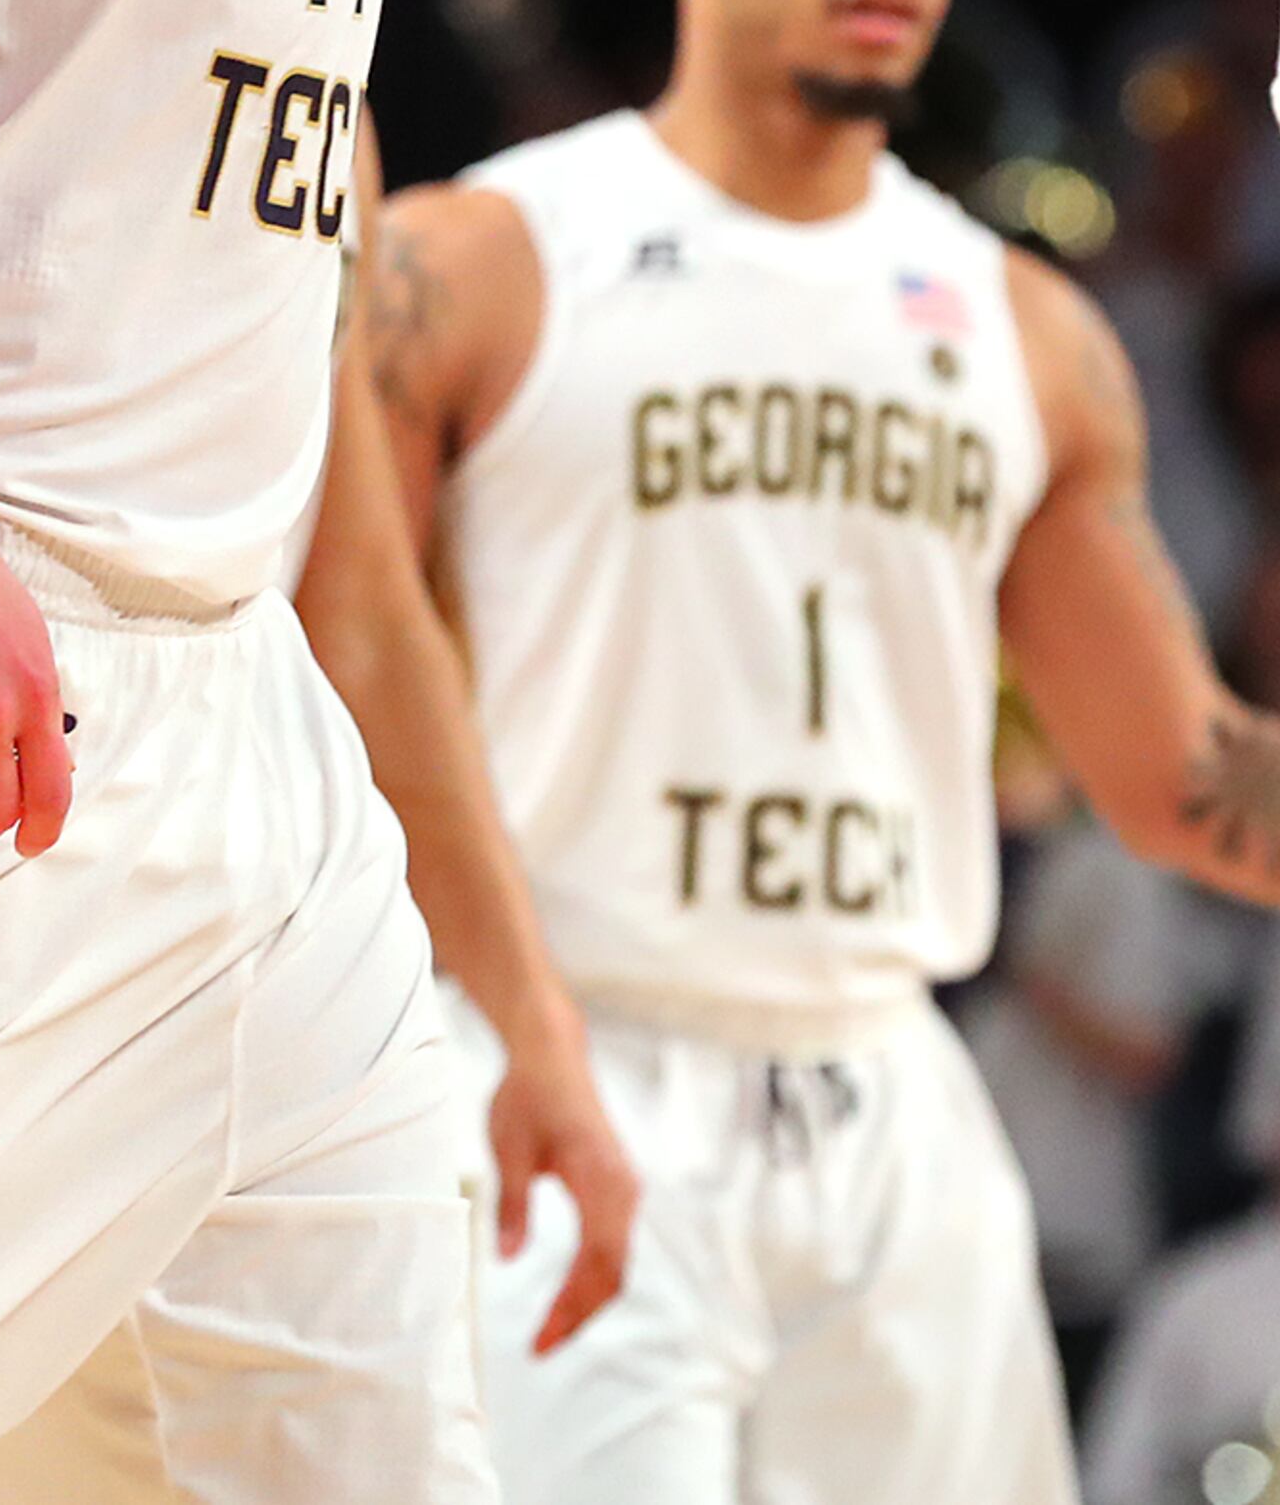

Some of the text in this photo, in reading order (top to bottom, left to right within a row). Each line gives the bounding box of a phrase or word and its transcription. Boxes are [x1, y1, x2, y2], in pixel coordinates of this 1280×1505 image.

[191, 49, 367, 243] TEC
[632, 380, 997, 552] GEORGIA
[798, 579, 831, 740] 1
